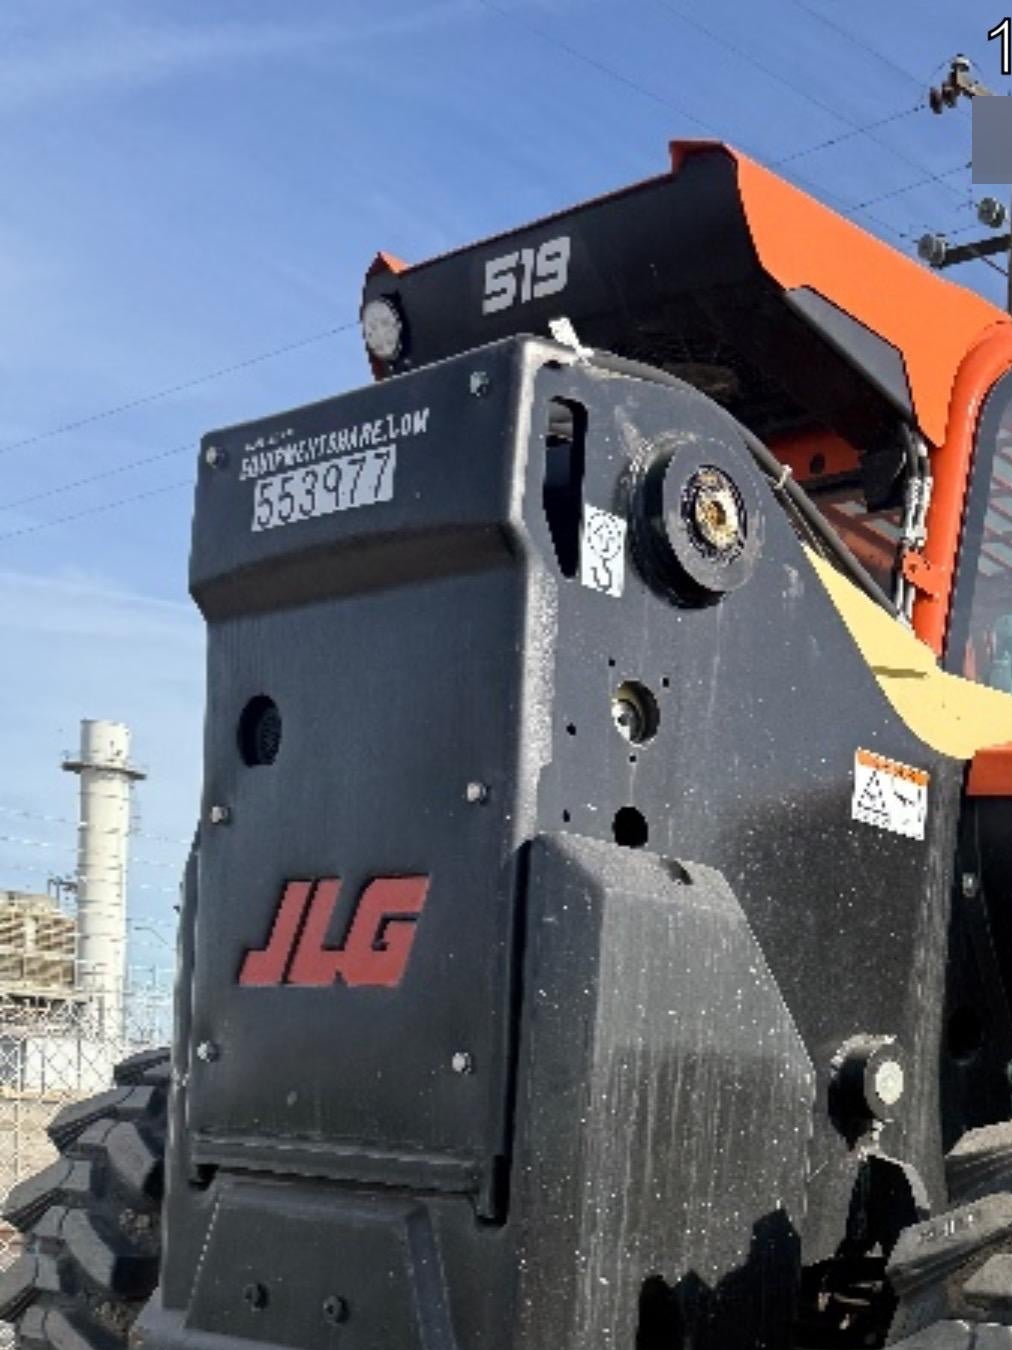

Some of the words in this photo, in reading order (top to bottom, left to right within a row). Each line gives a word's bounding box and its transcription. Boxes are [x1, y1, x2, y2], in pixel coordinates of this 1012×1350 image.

[482, 235, 571, 317] 519
[256, 450, 392, 527] 553977
[236, 873, 431, 988] JLG
